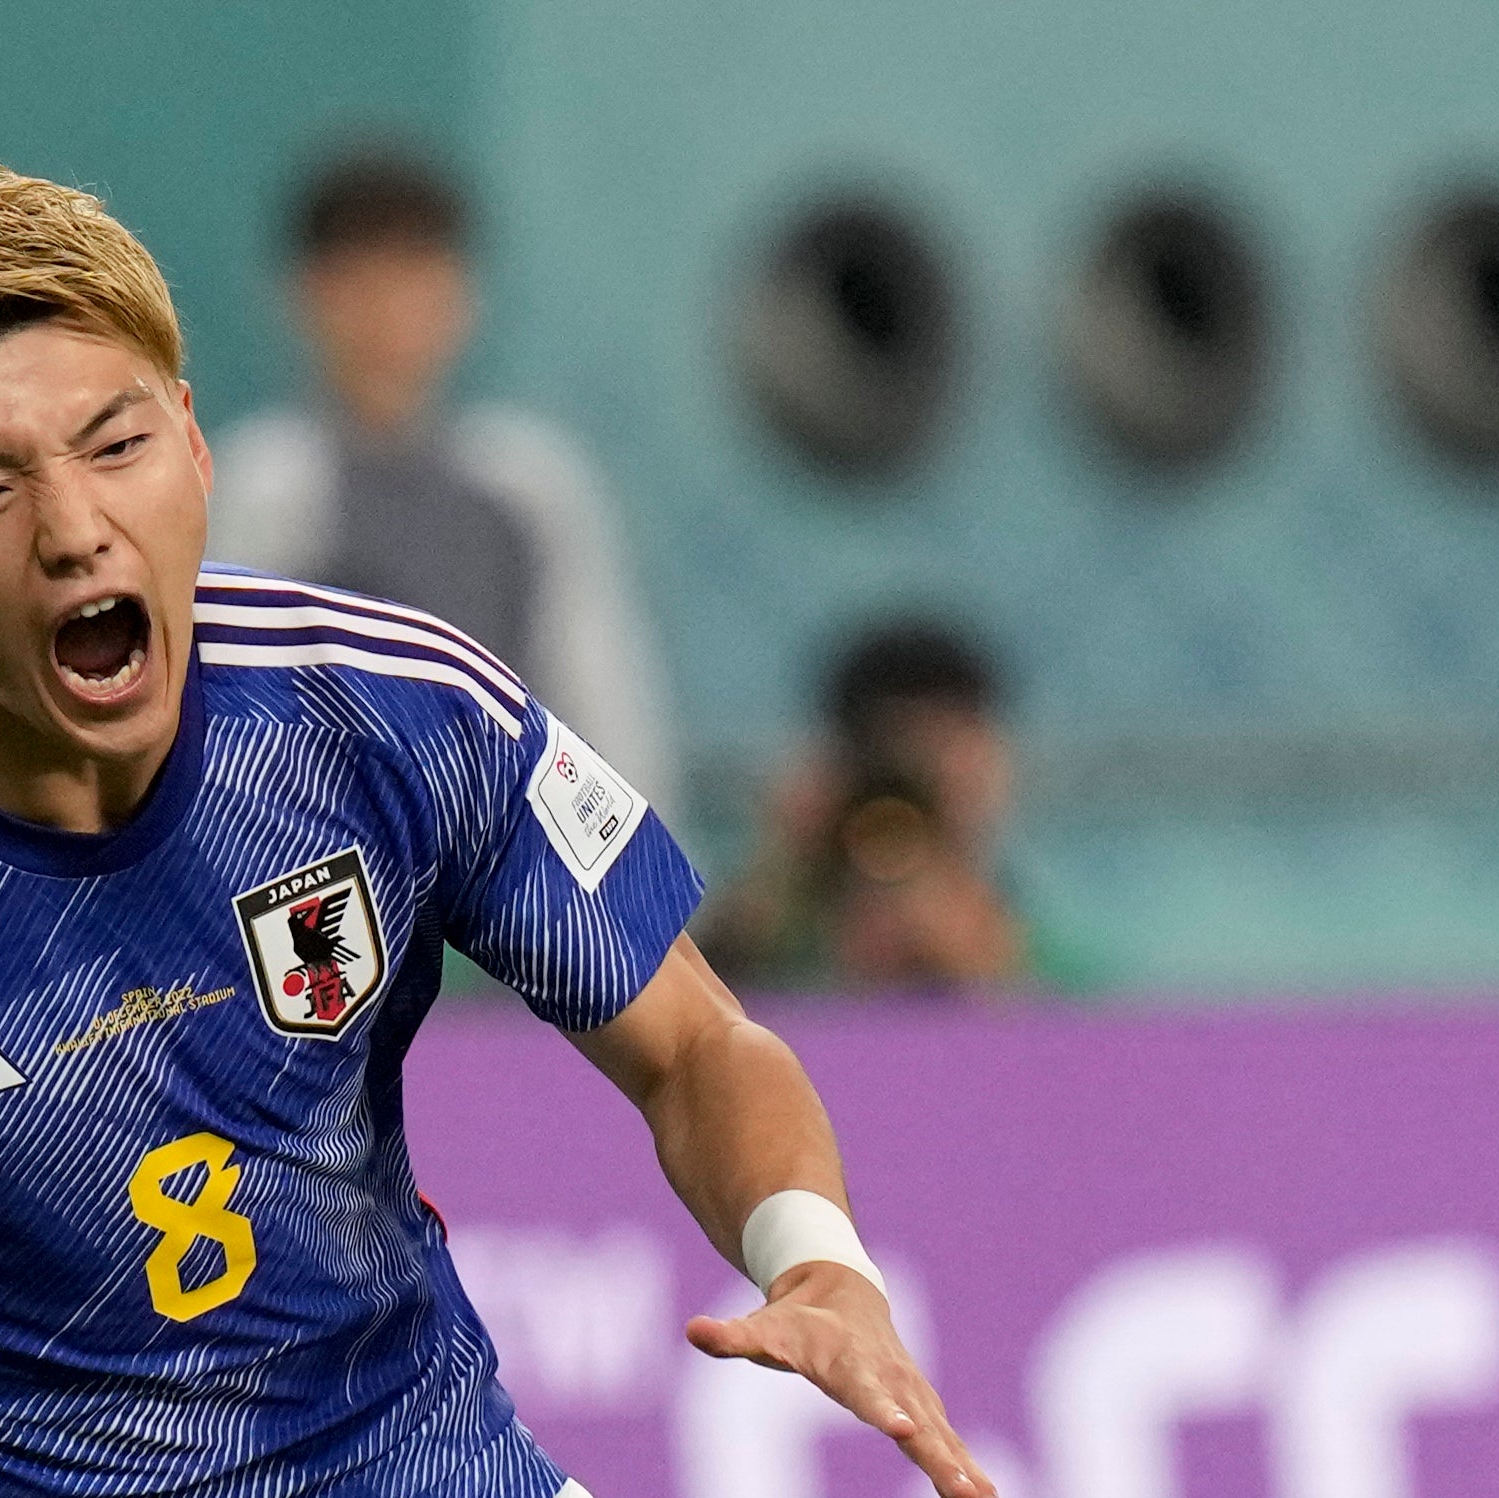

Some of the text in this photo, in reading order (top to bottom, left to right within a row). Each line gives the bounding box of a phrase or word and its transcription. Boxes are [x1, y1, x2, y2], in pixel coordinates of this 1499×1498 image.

[576, 780, 606, 824] UNITES
[268, 866, 332, 904] JAPAN
[189, 986, 235, 1010] STADIUM
[304, 976, 356, 1019] JFA
[128, 1131, 257, 1324] 8
